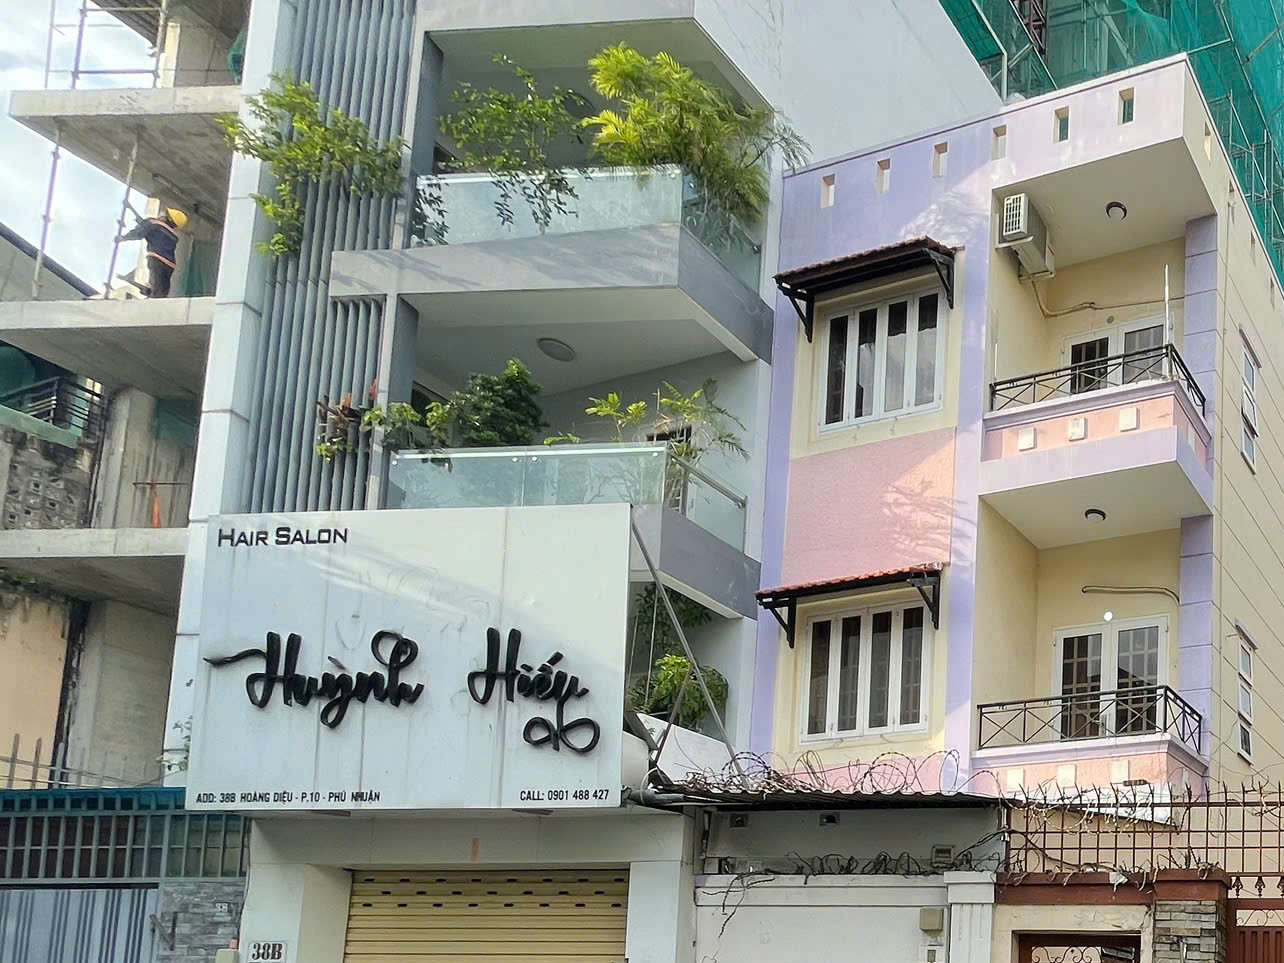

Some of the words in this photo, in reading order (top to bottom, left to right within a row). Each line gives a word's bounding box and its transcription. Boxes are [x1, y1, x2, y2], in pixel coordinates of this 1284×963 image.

[218, 528, 269, 547] HAIR
[275, 527, 348, 545] SALON
[196, 793, 216, 803] ADD:
[273, 790, 293, 804] DIỆU
[301, 791, 320, 803] P.10
[520, 790, 544, 801] CALL:
[547, 790, 569, 801] 0901
[572, 790, 590, 800] 488
[592, 789, 609, 800] 427
[252, 943, 283, 960] 38B
